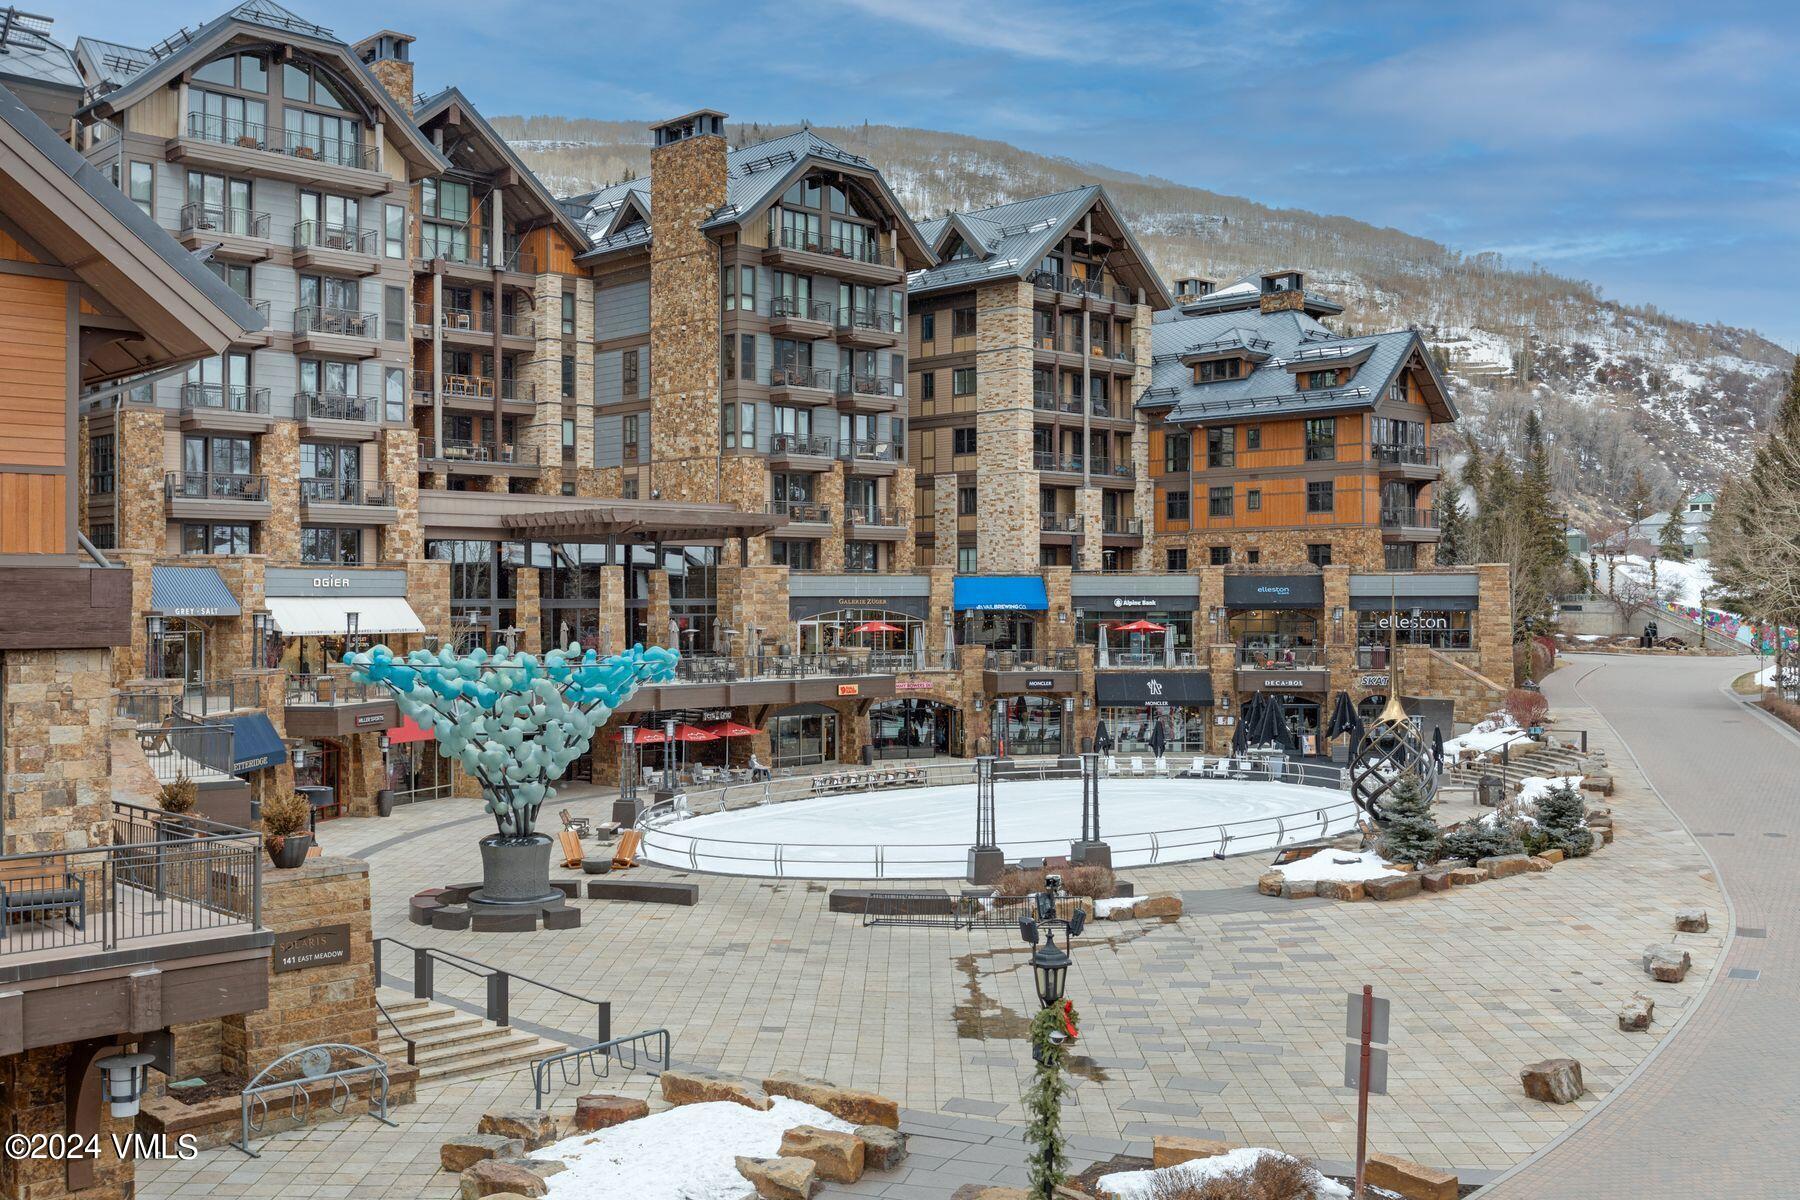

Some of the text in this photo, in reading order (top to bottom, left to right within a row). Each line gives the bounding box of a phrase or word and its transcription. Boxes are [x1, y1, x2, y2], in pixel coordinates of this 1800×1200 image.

[175, 607, 218, 615] GREY SALT
[1379, 616, 1446, 628] elleston
[233, 756, 268, 771] ETTERIDGE
[280, 937, 327, 951] SOLARIS
[283, 956, 296, 965] 141
[314, 951, 344, 960] MEADOW
